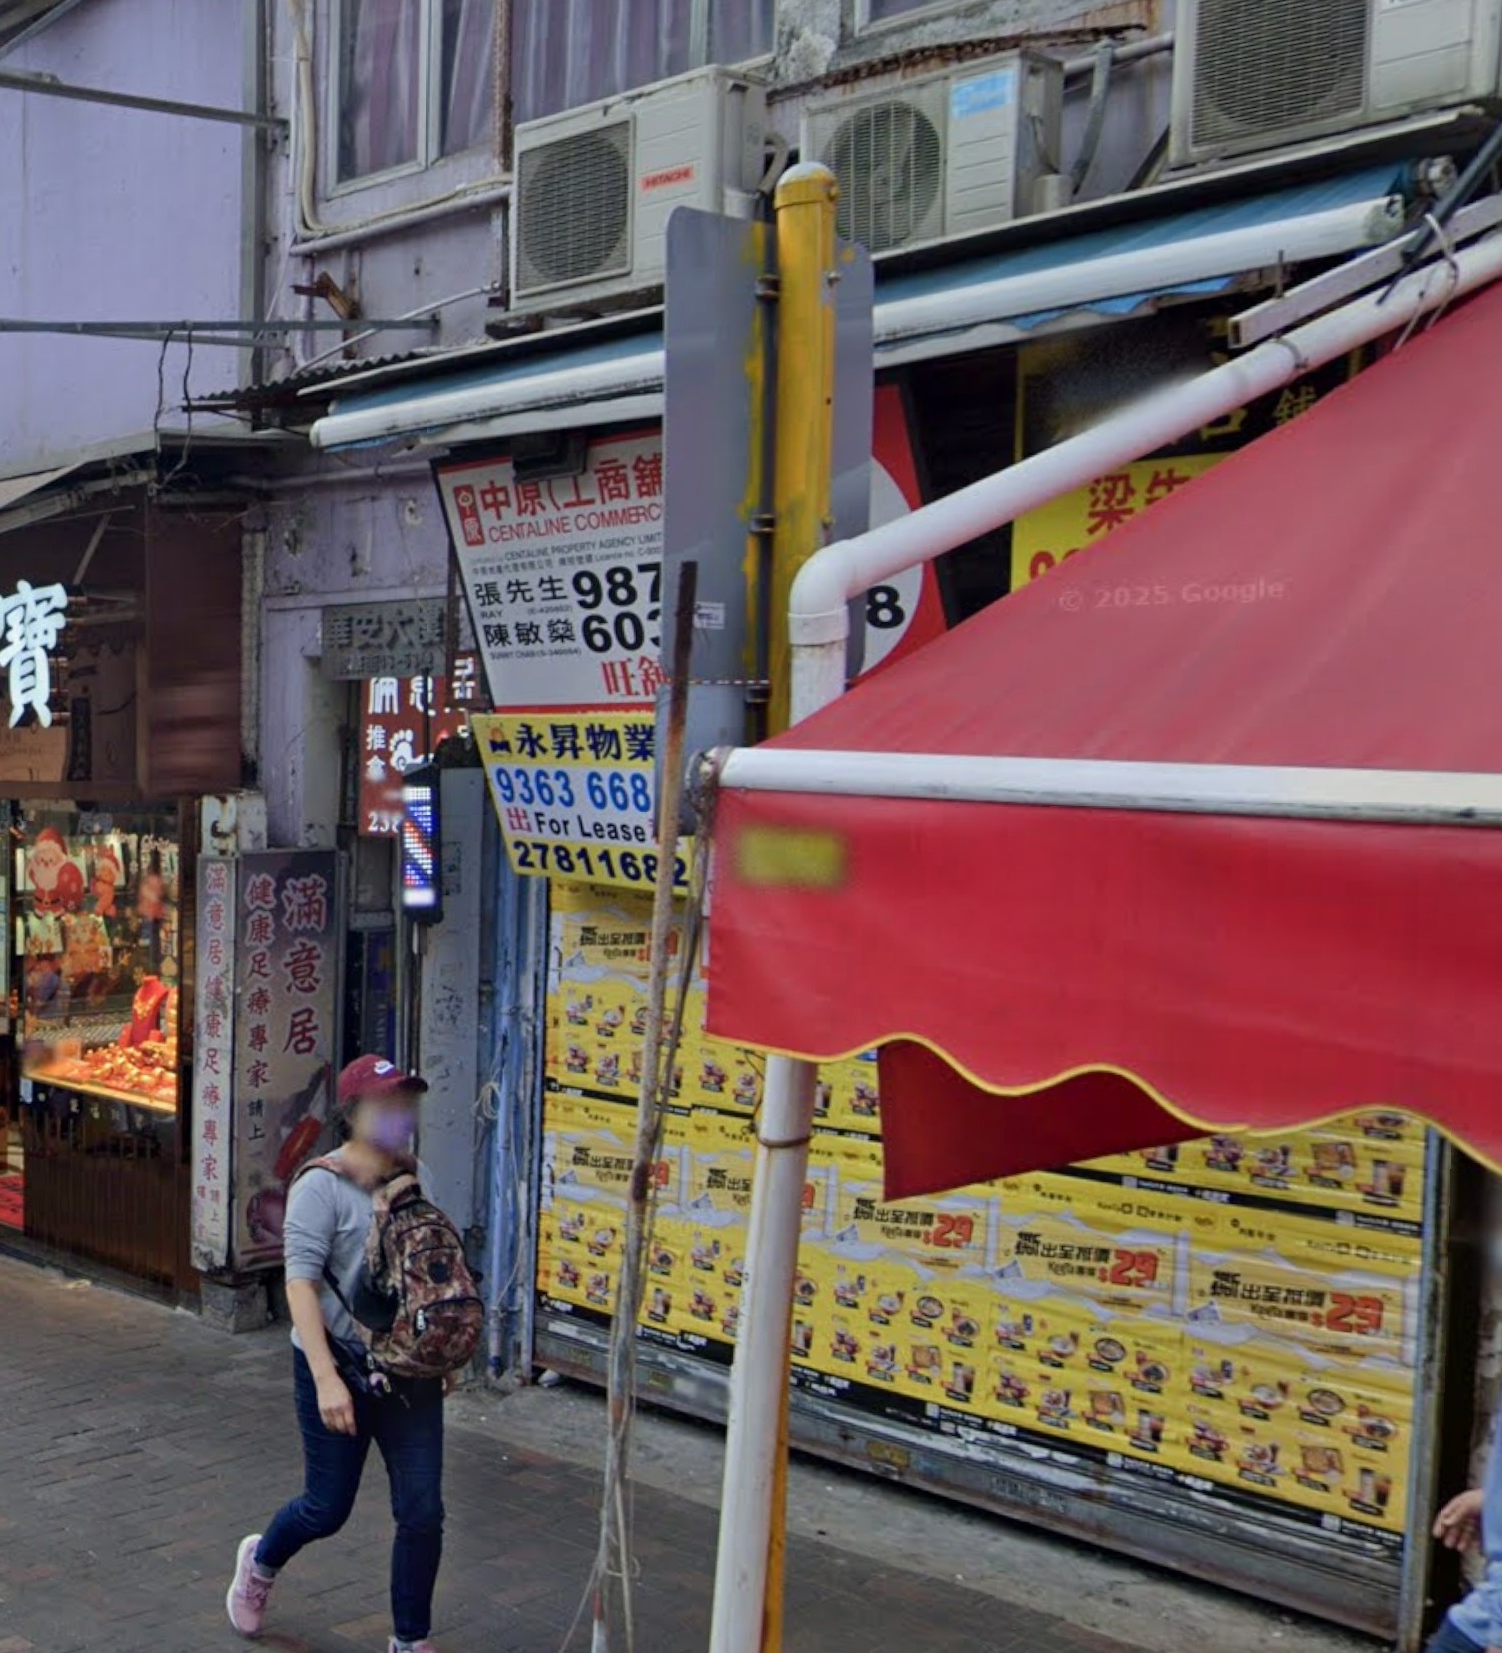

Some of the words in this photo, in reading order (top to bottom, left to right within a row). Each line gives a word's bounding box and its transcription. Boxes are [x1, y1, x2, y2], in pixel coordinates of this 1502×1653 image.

[644, 167, 693, 190] HITACHI
[489, 517, 570, 543] CENTALINE
[504, 547, 549, 561] CENTALINE
[551, 541, 596, 555] PROPERTY
[599, 536, 636, 550] AGENCY
[473, 575, 568, 607] 張先生
[572, 561, 662, 610] 987
[480, 610, 503, 619] RAY
[514, 722, 655, 761] 永昇物業
[495, 767, 575, 808] 9363
[507, 807, 532, 832] 出
[535, 811, 570, 836] For
[577, 815, 646, 842] Lease
[282, 875, 327, 1056] 滿意居
